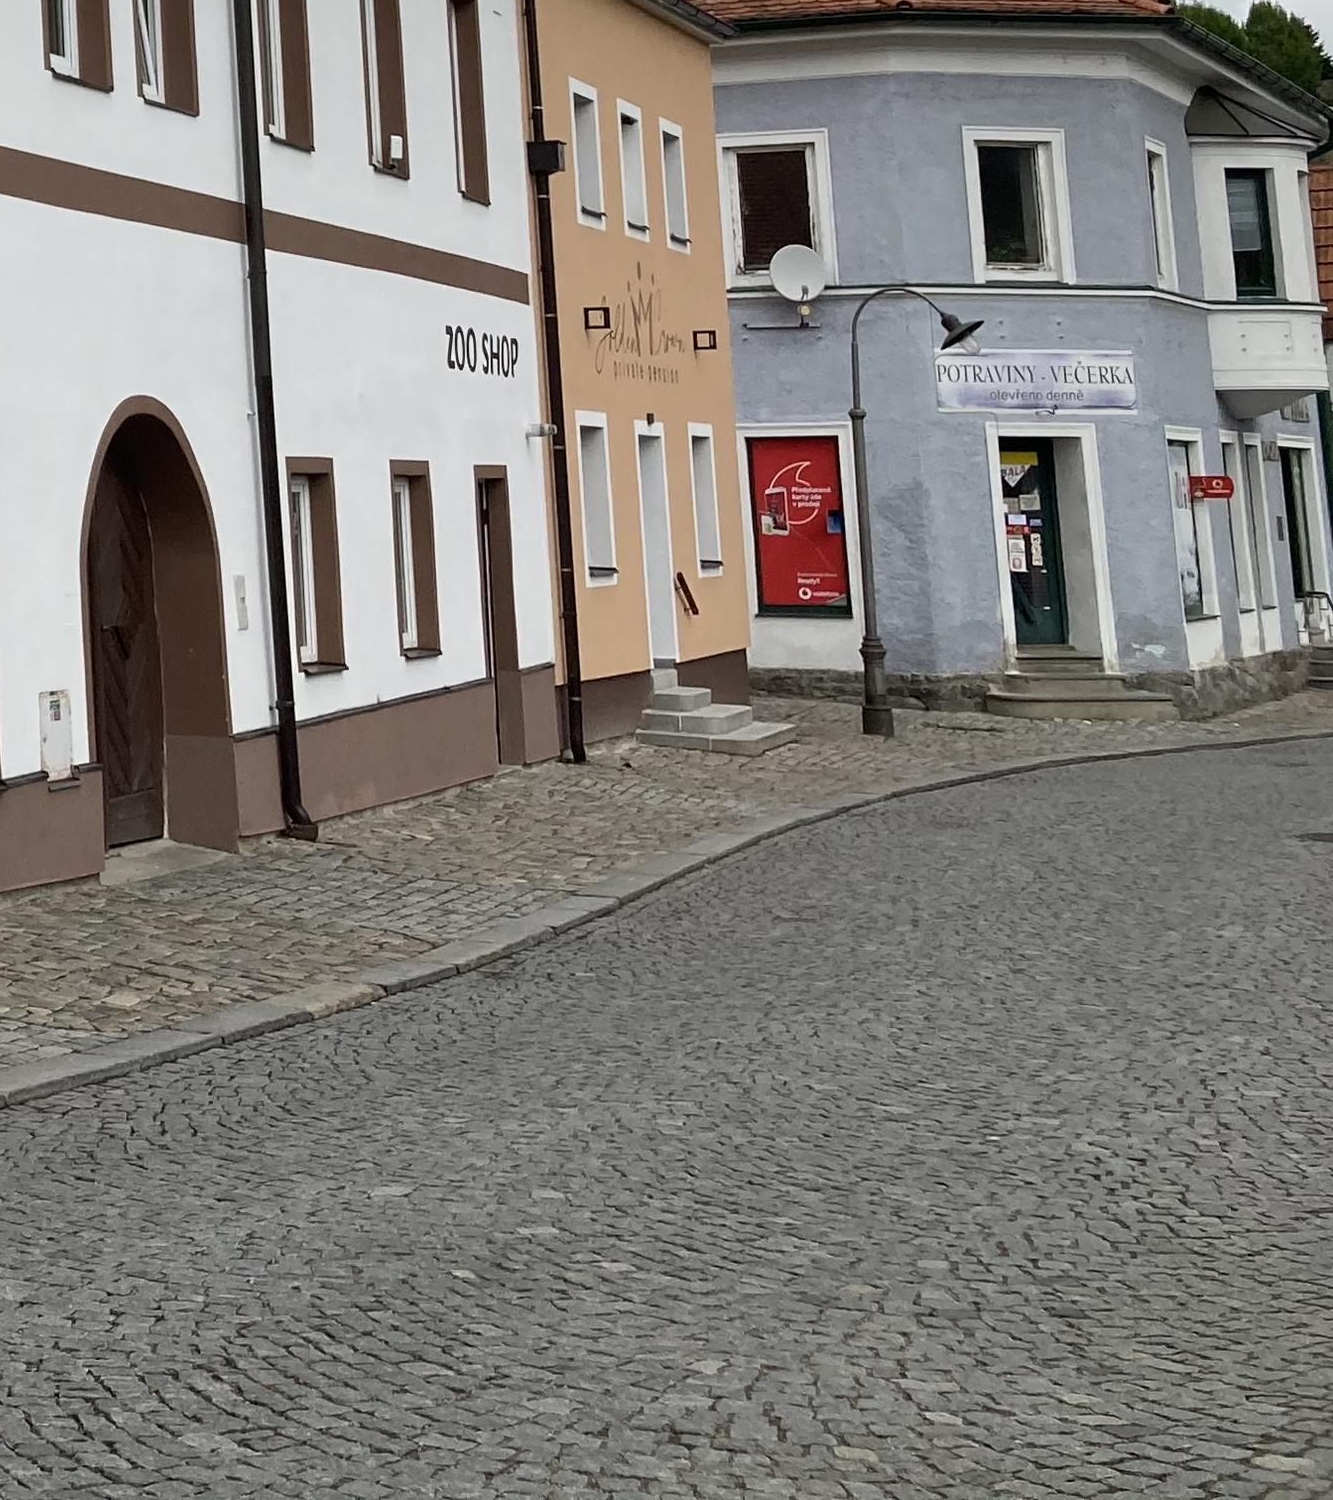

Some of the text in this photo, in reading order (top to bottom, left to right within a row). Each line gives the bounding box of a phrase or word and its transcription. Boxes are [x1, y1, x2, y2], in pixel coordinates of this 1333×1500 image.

[445, 324, 519, 378] ZOO SHOP
[936, 363, 1036, 384] POTRAVINY
[1050, 361, 1134, 385] VEČERKA
[989, 389, 1084, 401] otevřeno denně
